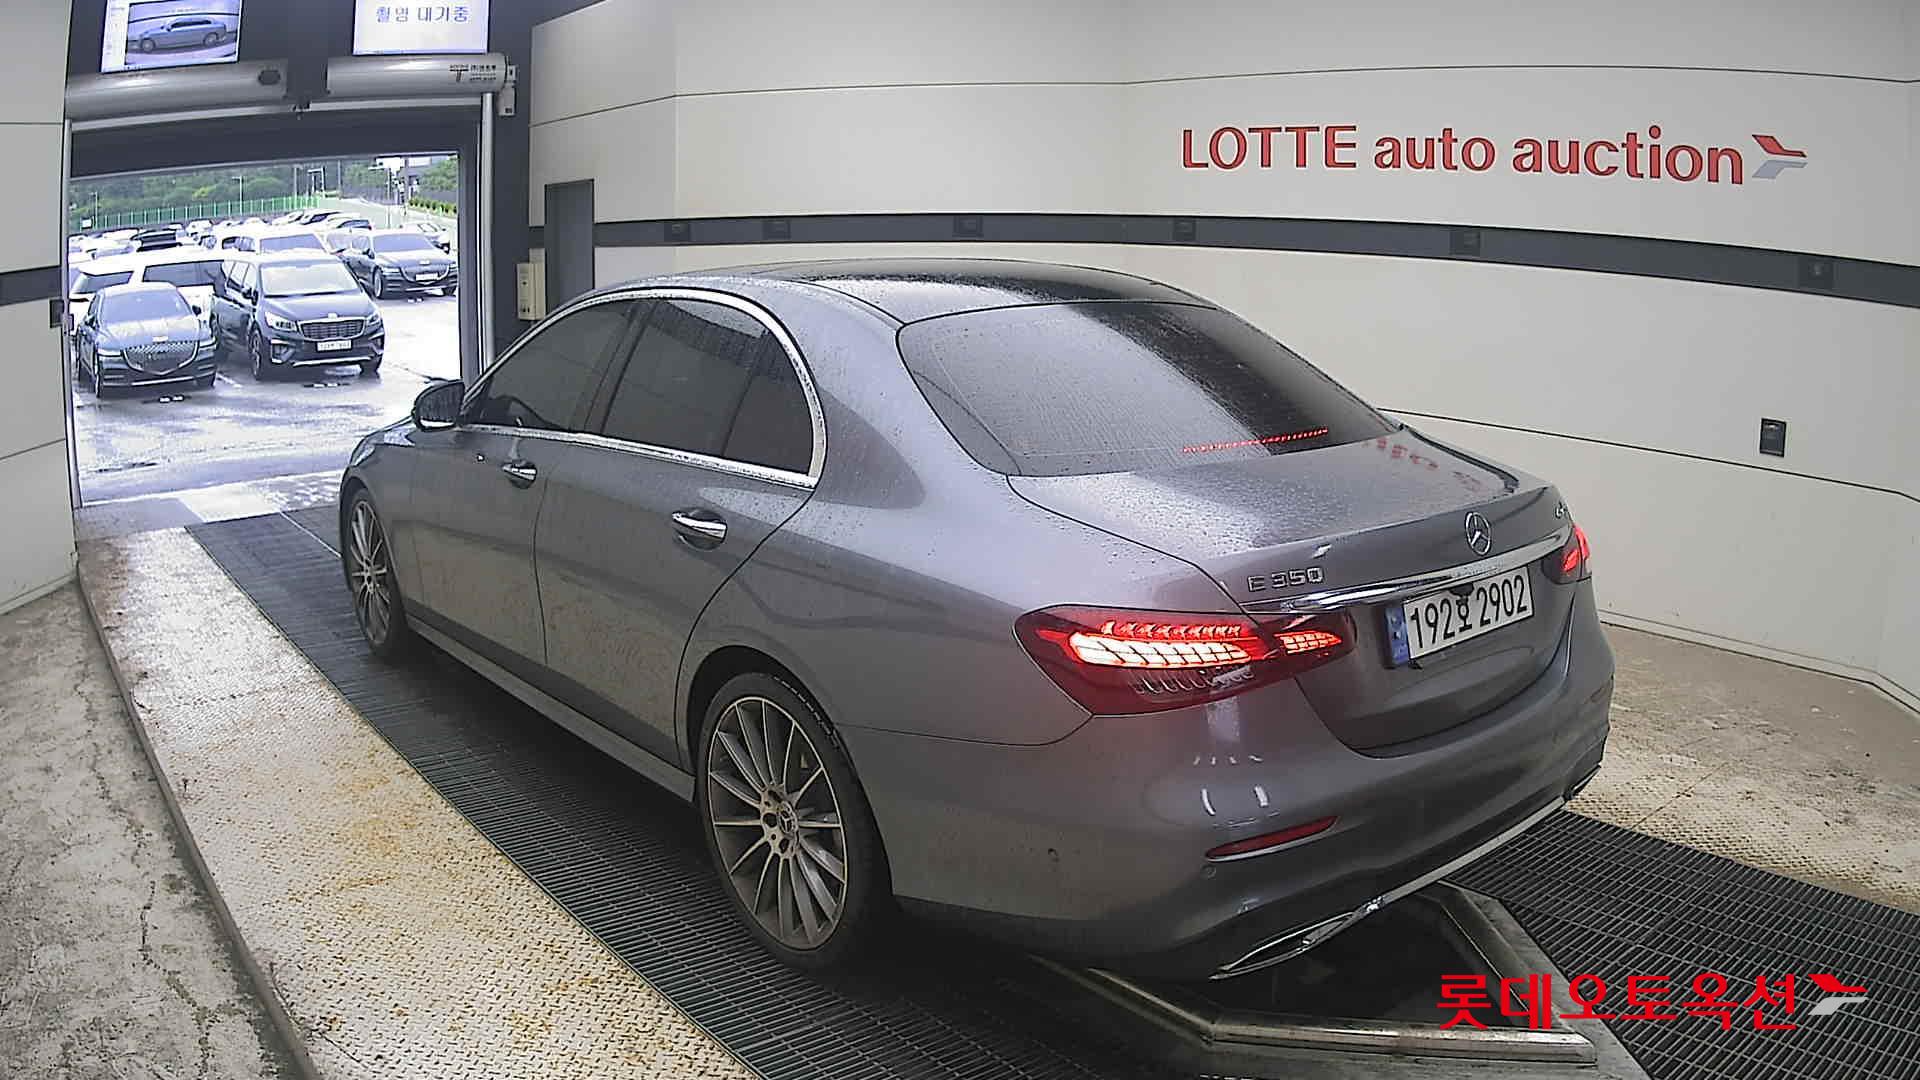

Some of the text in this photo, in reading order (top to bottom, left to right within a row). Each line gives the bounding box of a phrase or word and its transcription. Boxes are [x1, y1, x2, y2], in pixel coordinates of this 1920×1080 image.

[1182, 125, 1744, 185] LOTTE auto auction
[1247, 566, 1324, 592] E 350
[1476, 574, 1528, 627] 2902
